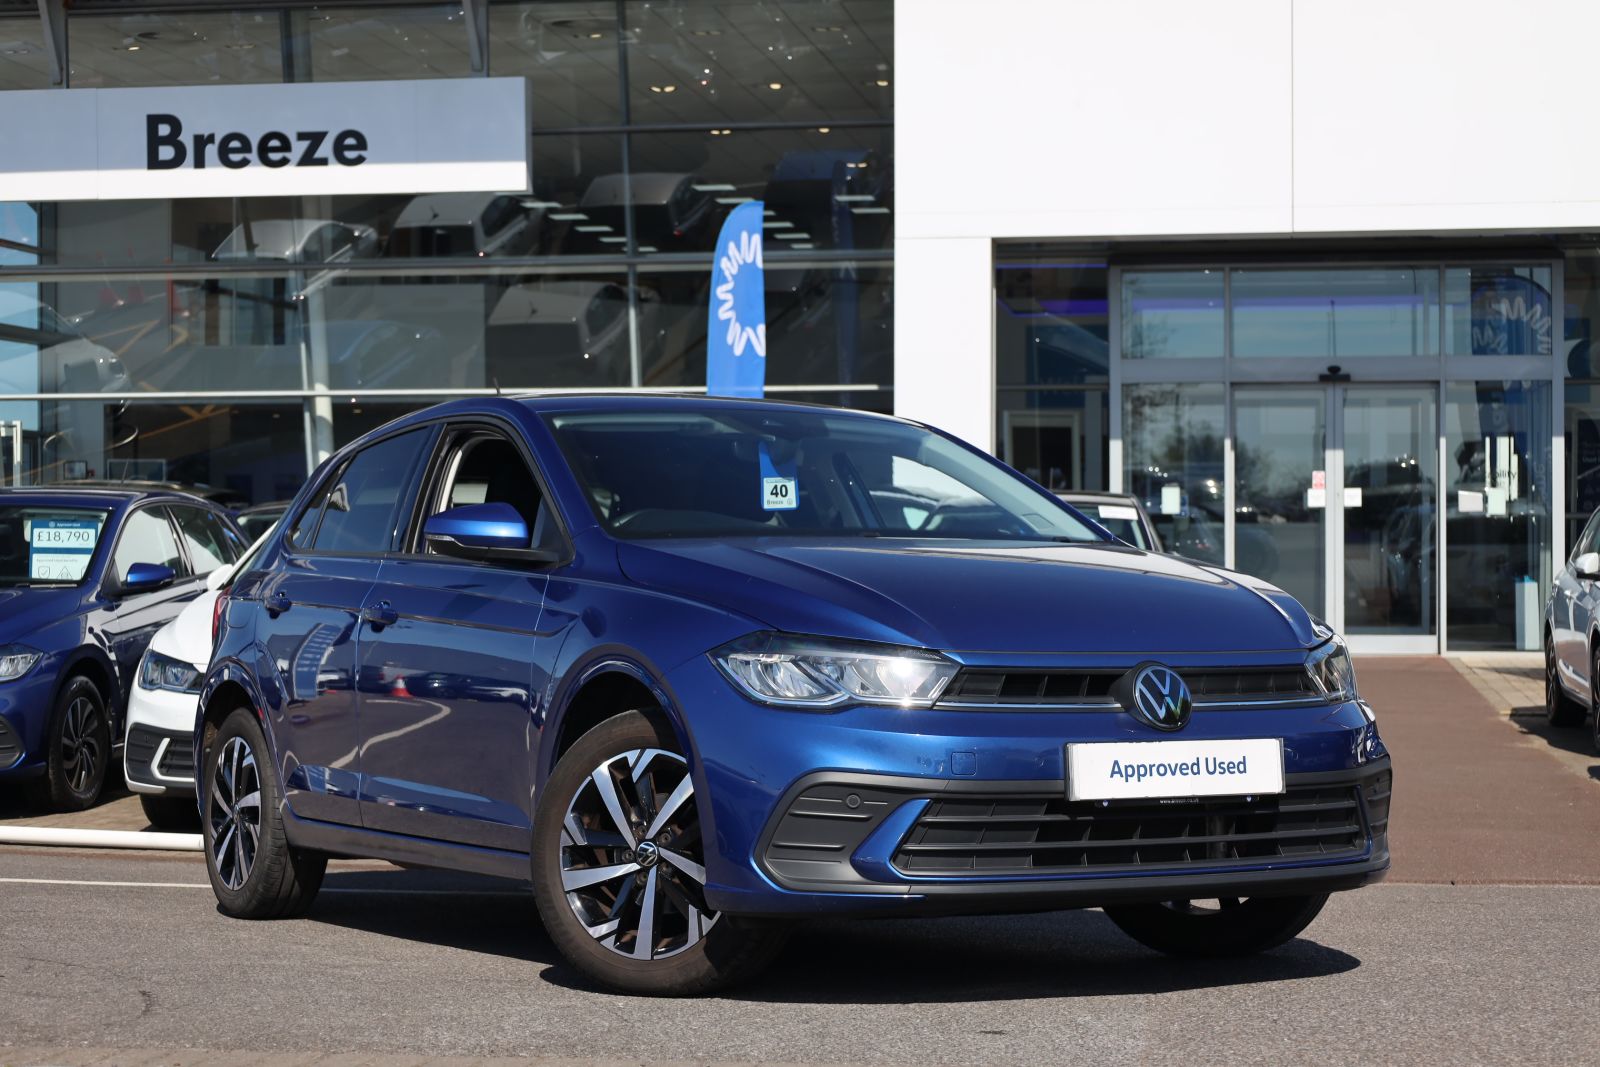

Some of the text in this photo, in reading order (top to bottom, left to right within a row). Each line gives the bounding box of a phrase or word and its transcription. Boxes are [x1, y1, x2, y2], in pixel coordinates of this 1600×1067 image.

[146, 113, 368, 170] Breeze
[770, 484, 788, 498] 40
[37, 530, 90, 543] £18,790
[1109, 756, 1247, 782] Approved Used
